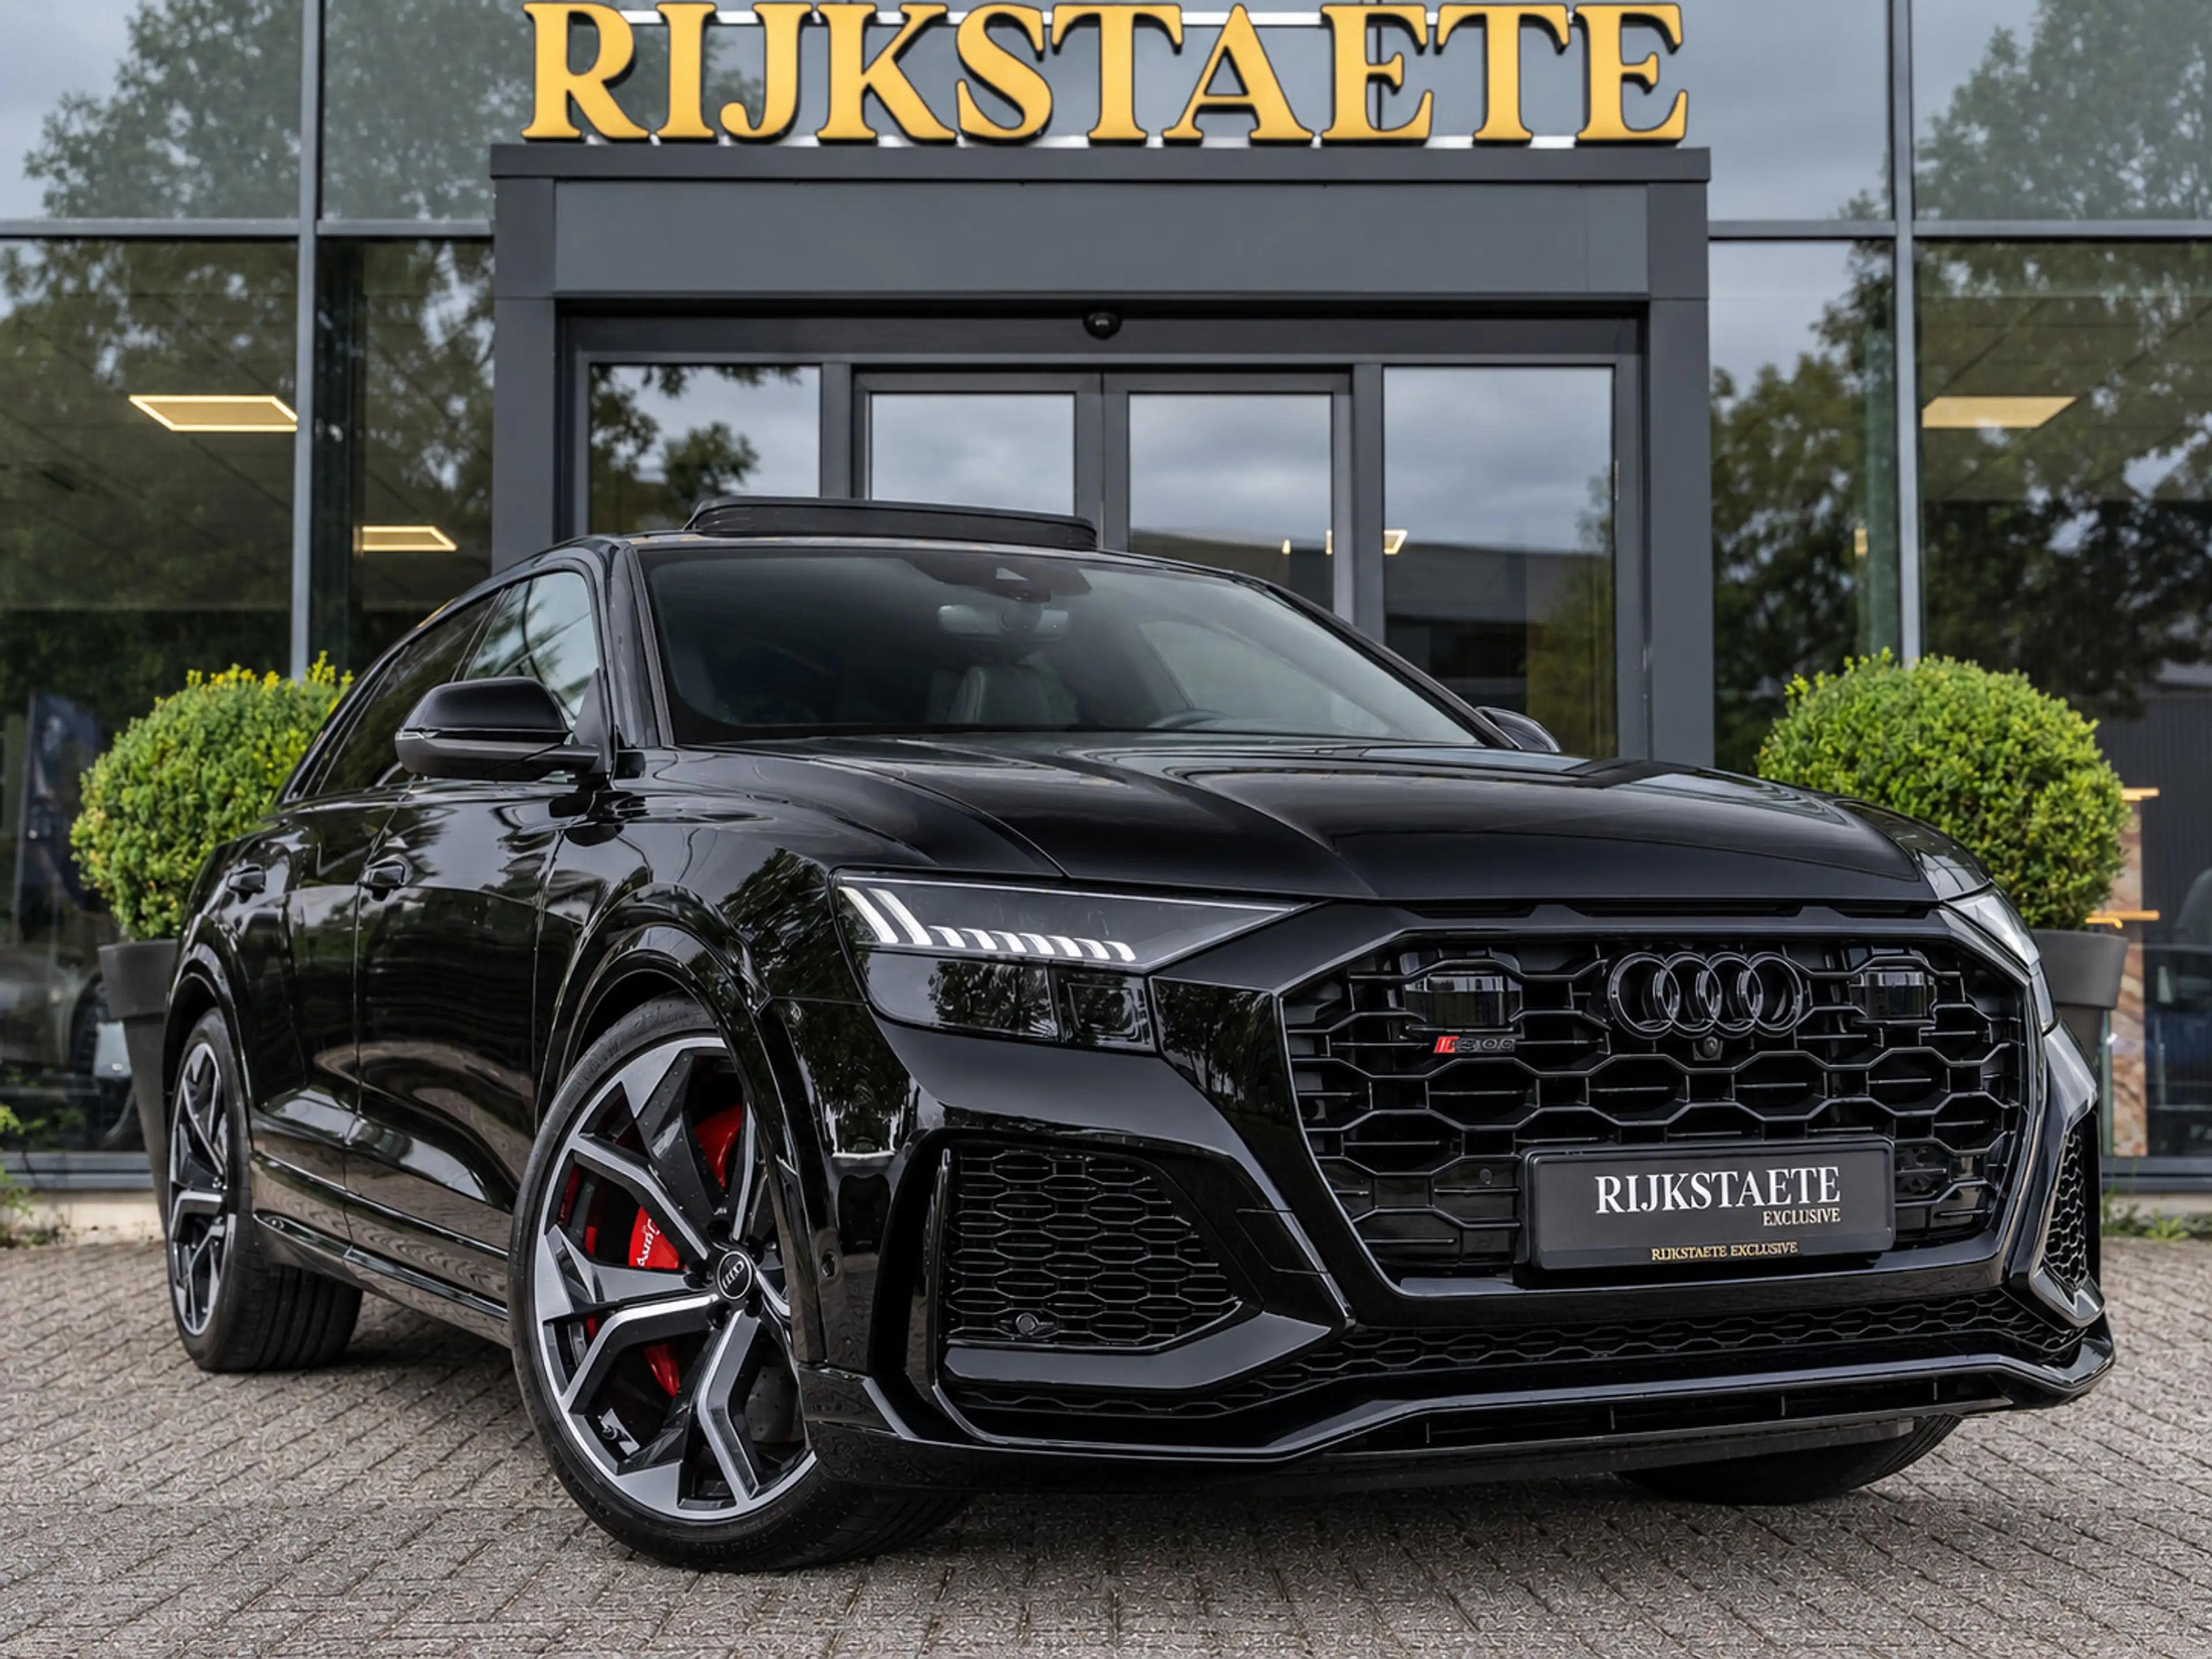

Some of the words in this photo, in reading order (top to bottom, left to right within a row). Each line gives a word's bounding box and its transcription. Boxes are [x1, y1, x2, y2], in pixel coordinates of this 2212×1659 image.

[521, 2, 1688, 143] RIJKSTAETE
[1594, 1166, 1841, 1214] RIJKSTAETE
[1763, 1208, 1841, 1226] EXCLUSIVE
[1730, 1241, 1798, 1256] EXCLUSIVE
